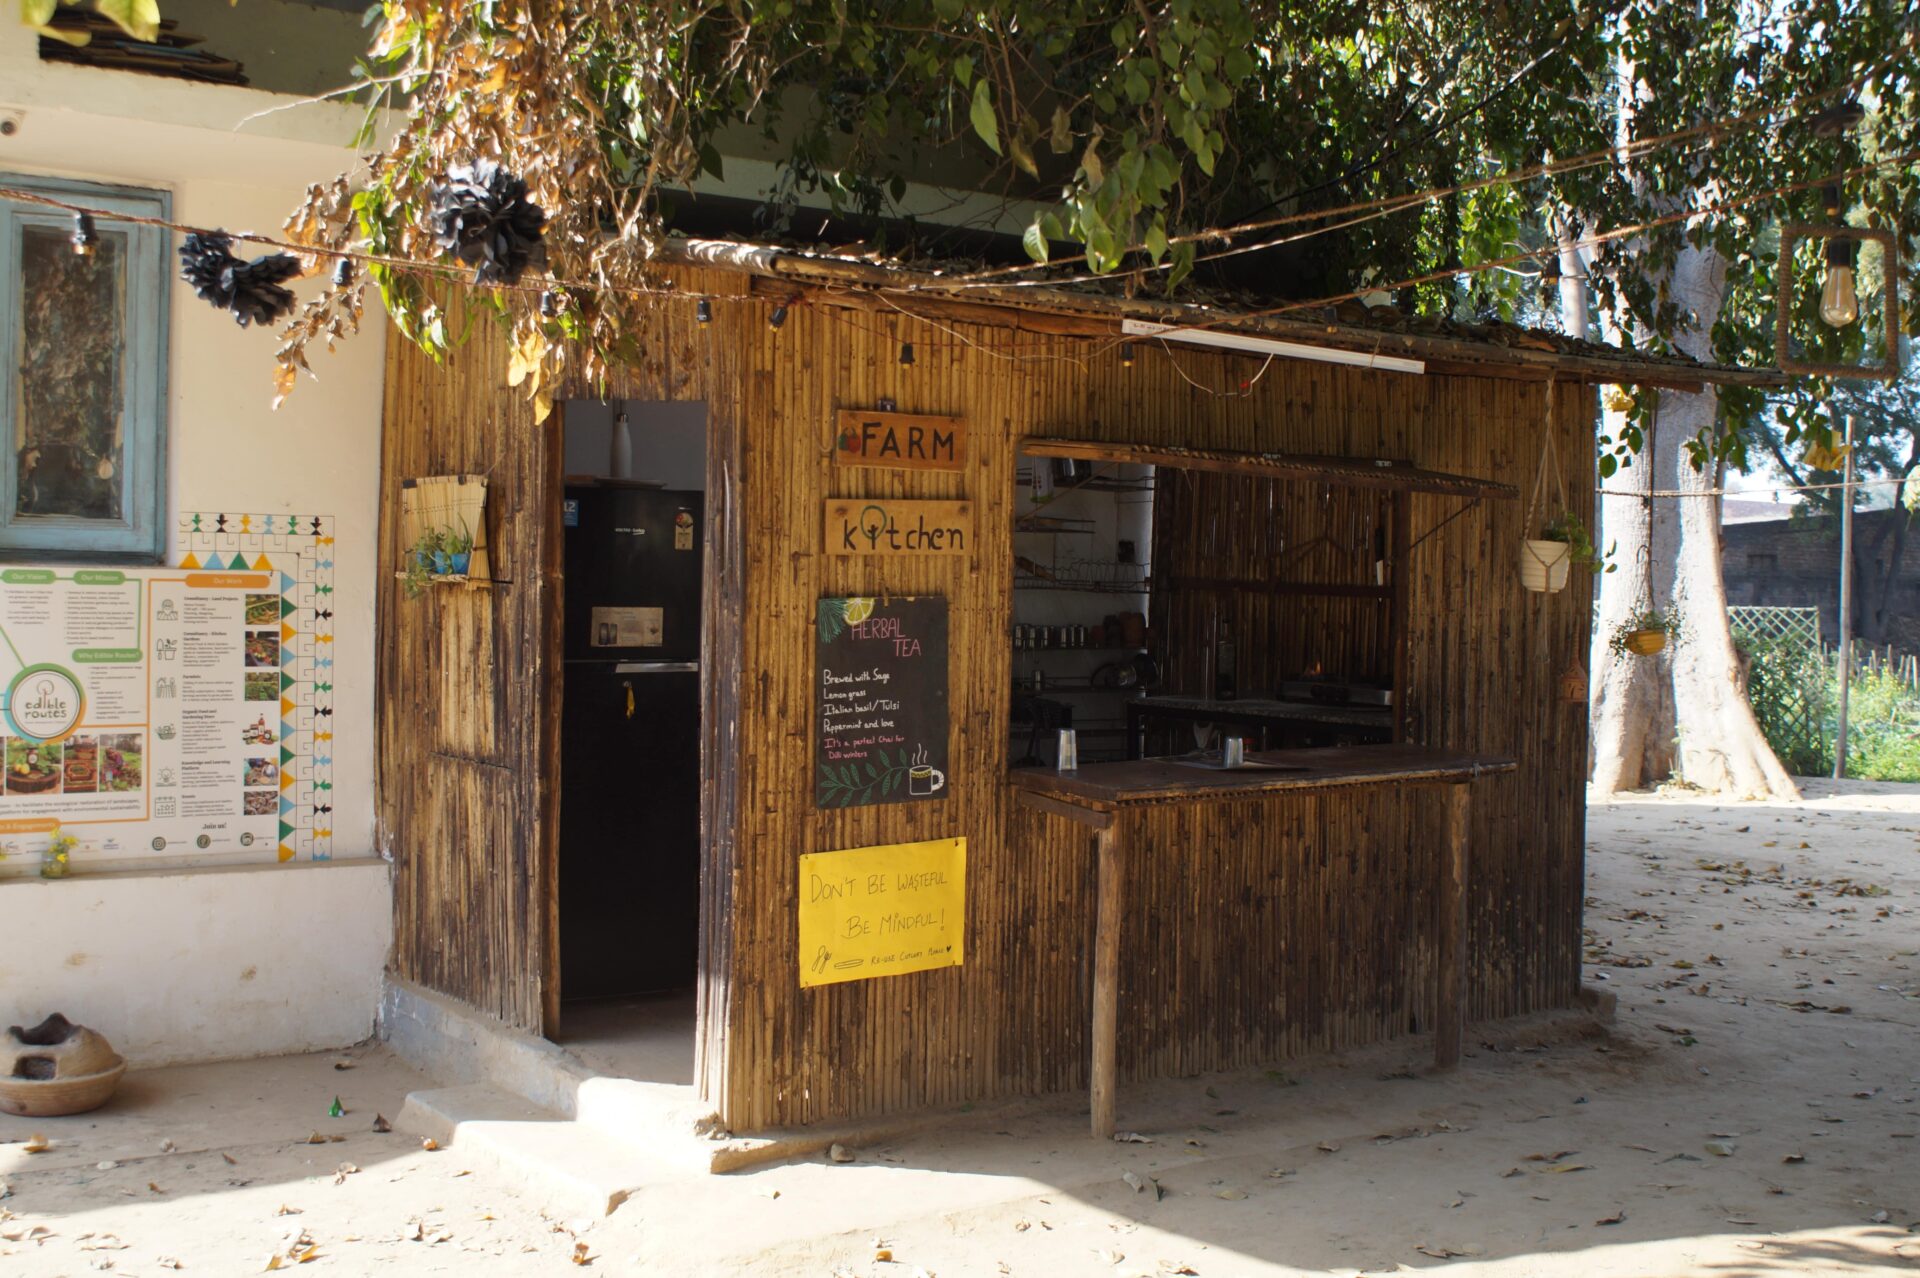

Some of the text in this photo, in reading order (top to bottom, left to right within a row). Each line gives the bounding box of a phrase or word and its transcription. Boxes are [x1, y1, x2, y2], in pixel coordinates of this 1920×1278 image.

[861, 422, 954, 461] FARM
[12, 572, 25, 581] Our
[81, 573, 94, 582] Our
[850, 618, 906, 640] HERBAL
[892, 637, 922, 657] TEA
[94, 652, 114, 660] Edible
[823, 667, 891, 685] Brewed with Sage
[823, 687, 867, 701] Lemon grass
[25, 696, 67, 709] edible
[25, 710, 68, 719] routes
[823, 704, 853, 716] Italian
[823, 718, 895, 734] Peppermint and love
[824, 738, 842, 749] It's
[853, 736, 875, 749] perfect
[218, 821, 227, 829] us!
[811, 872, 948, 903] DON'T BE WASTEFUL
[841, 915, 871, 939] BE
